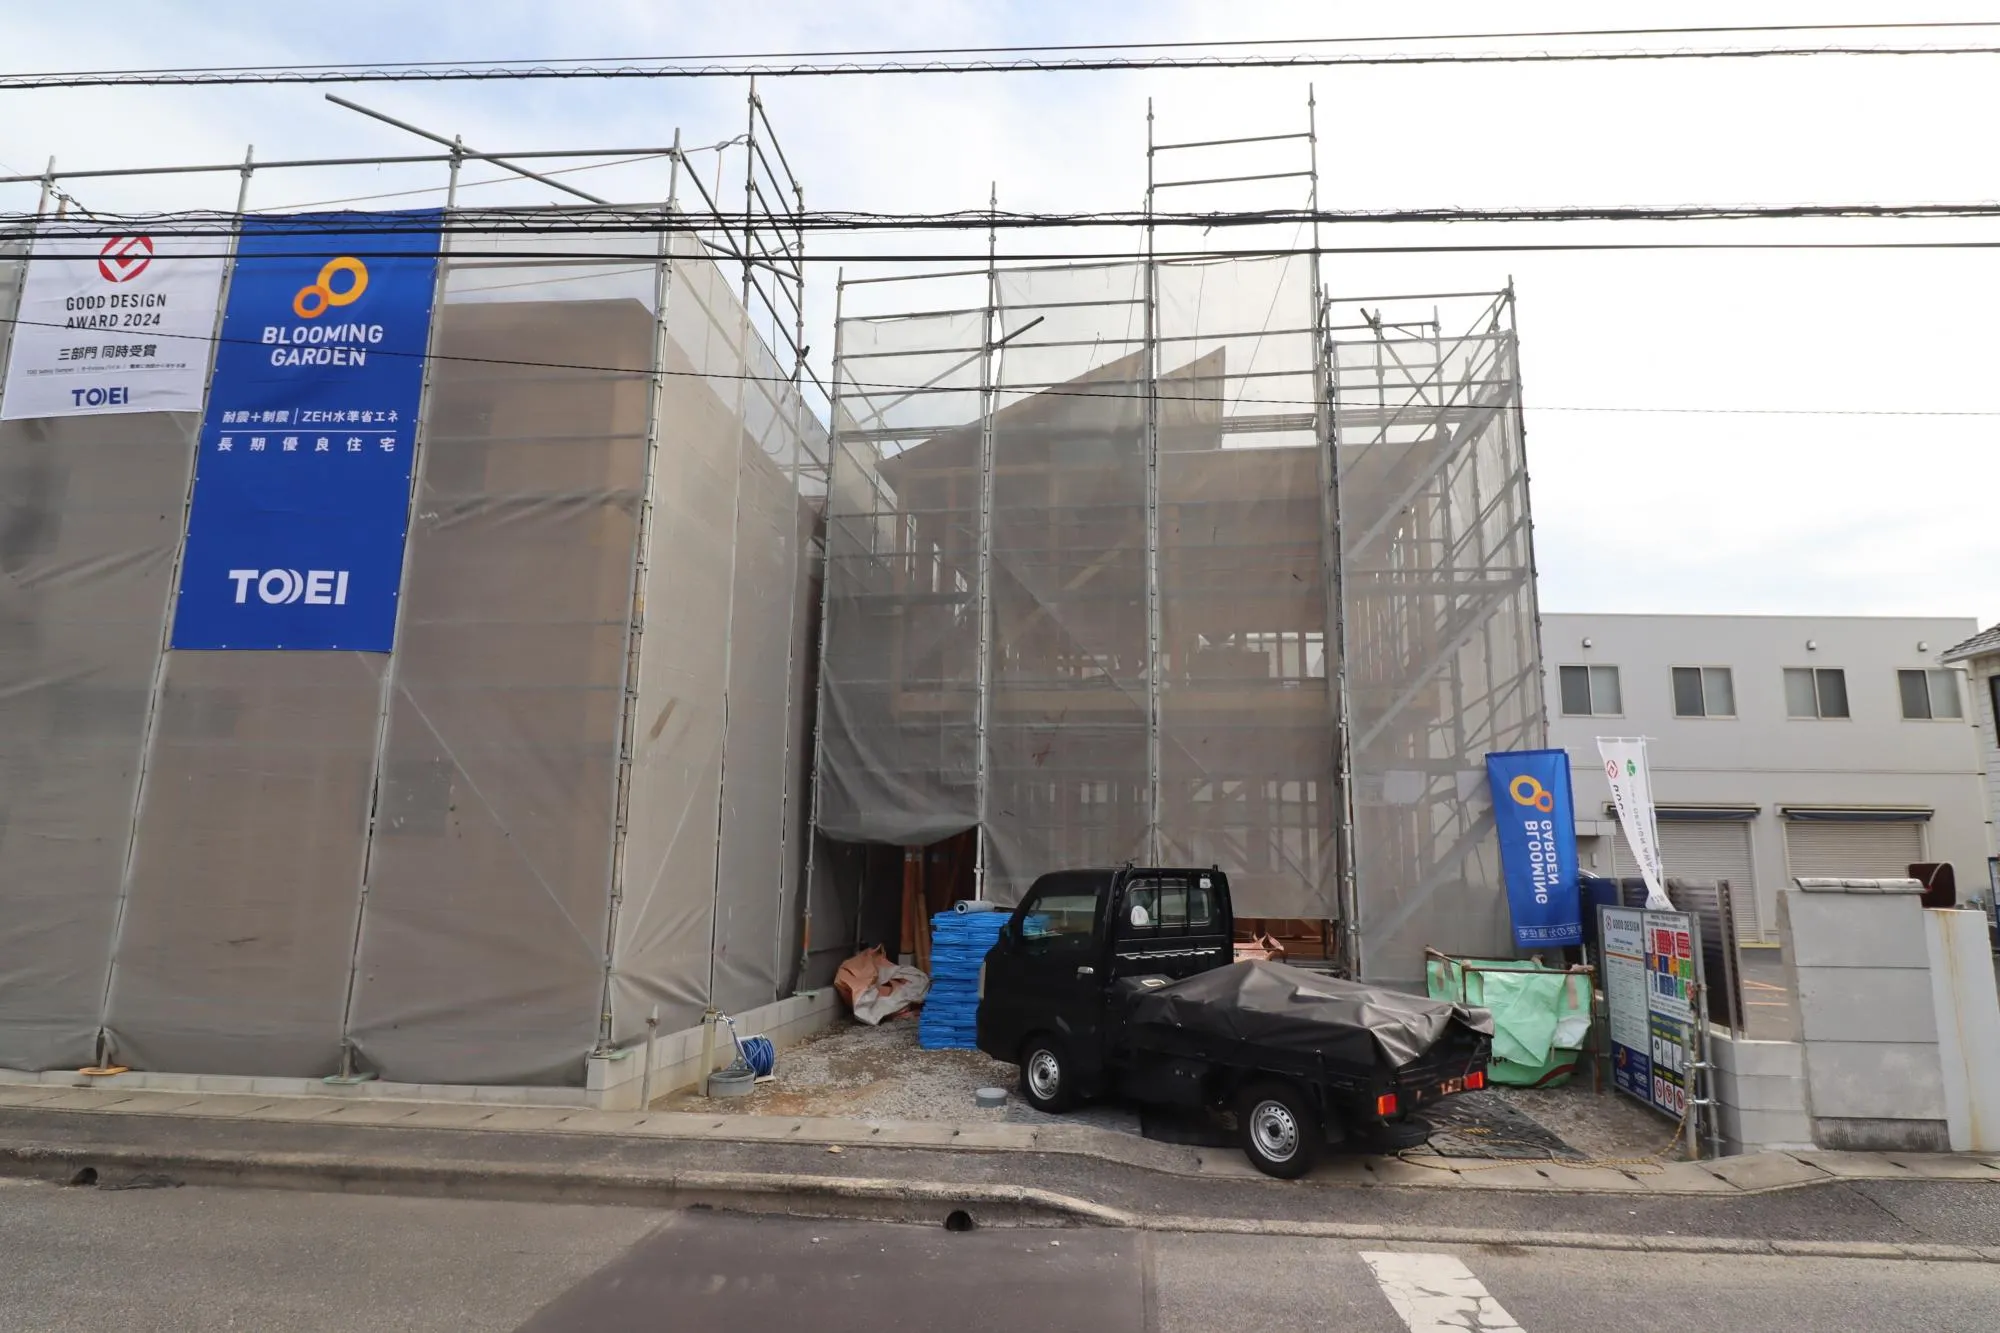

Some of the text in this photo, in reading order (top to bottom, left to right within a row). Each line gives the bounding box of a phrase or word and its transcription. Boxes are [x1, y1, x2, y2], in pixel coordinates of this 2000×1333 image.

[66, 293, 167, 311] GOOD DESIGN
[65, 312, 161, 330] AWARD 2024
[261, 323, 384, 345] BLOOMING
[57, 343, 158, 361] 三部門 同時受賞
[270, 346, 367, 367] GARDEN
[301, 409, 399, 424] ZEH水準省エネ
